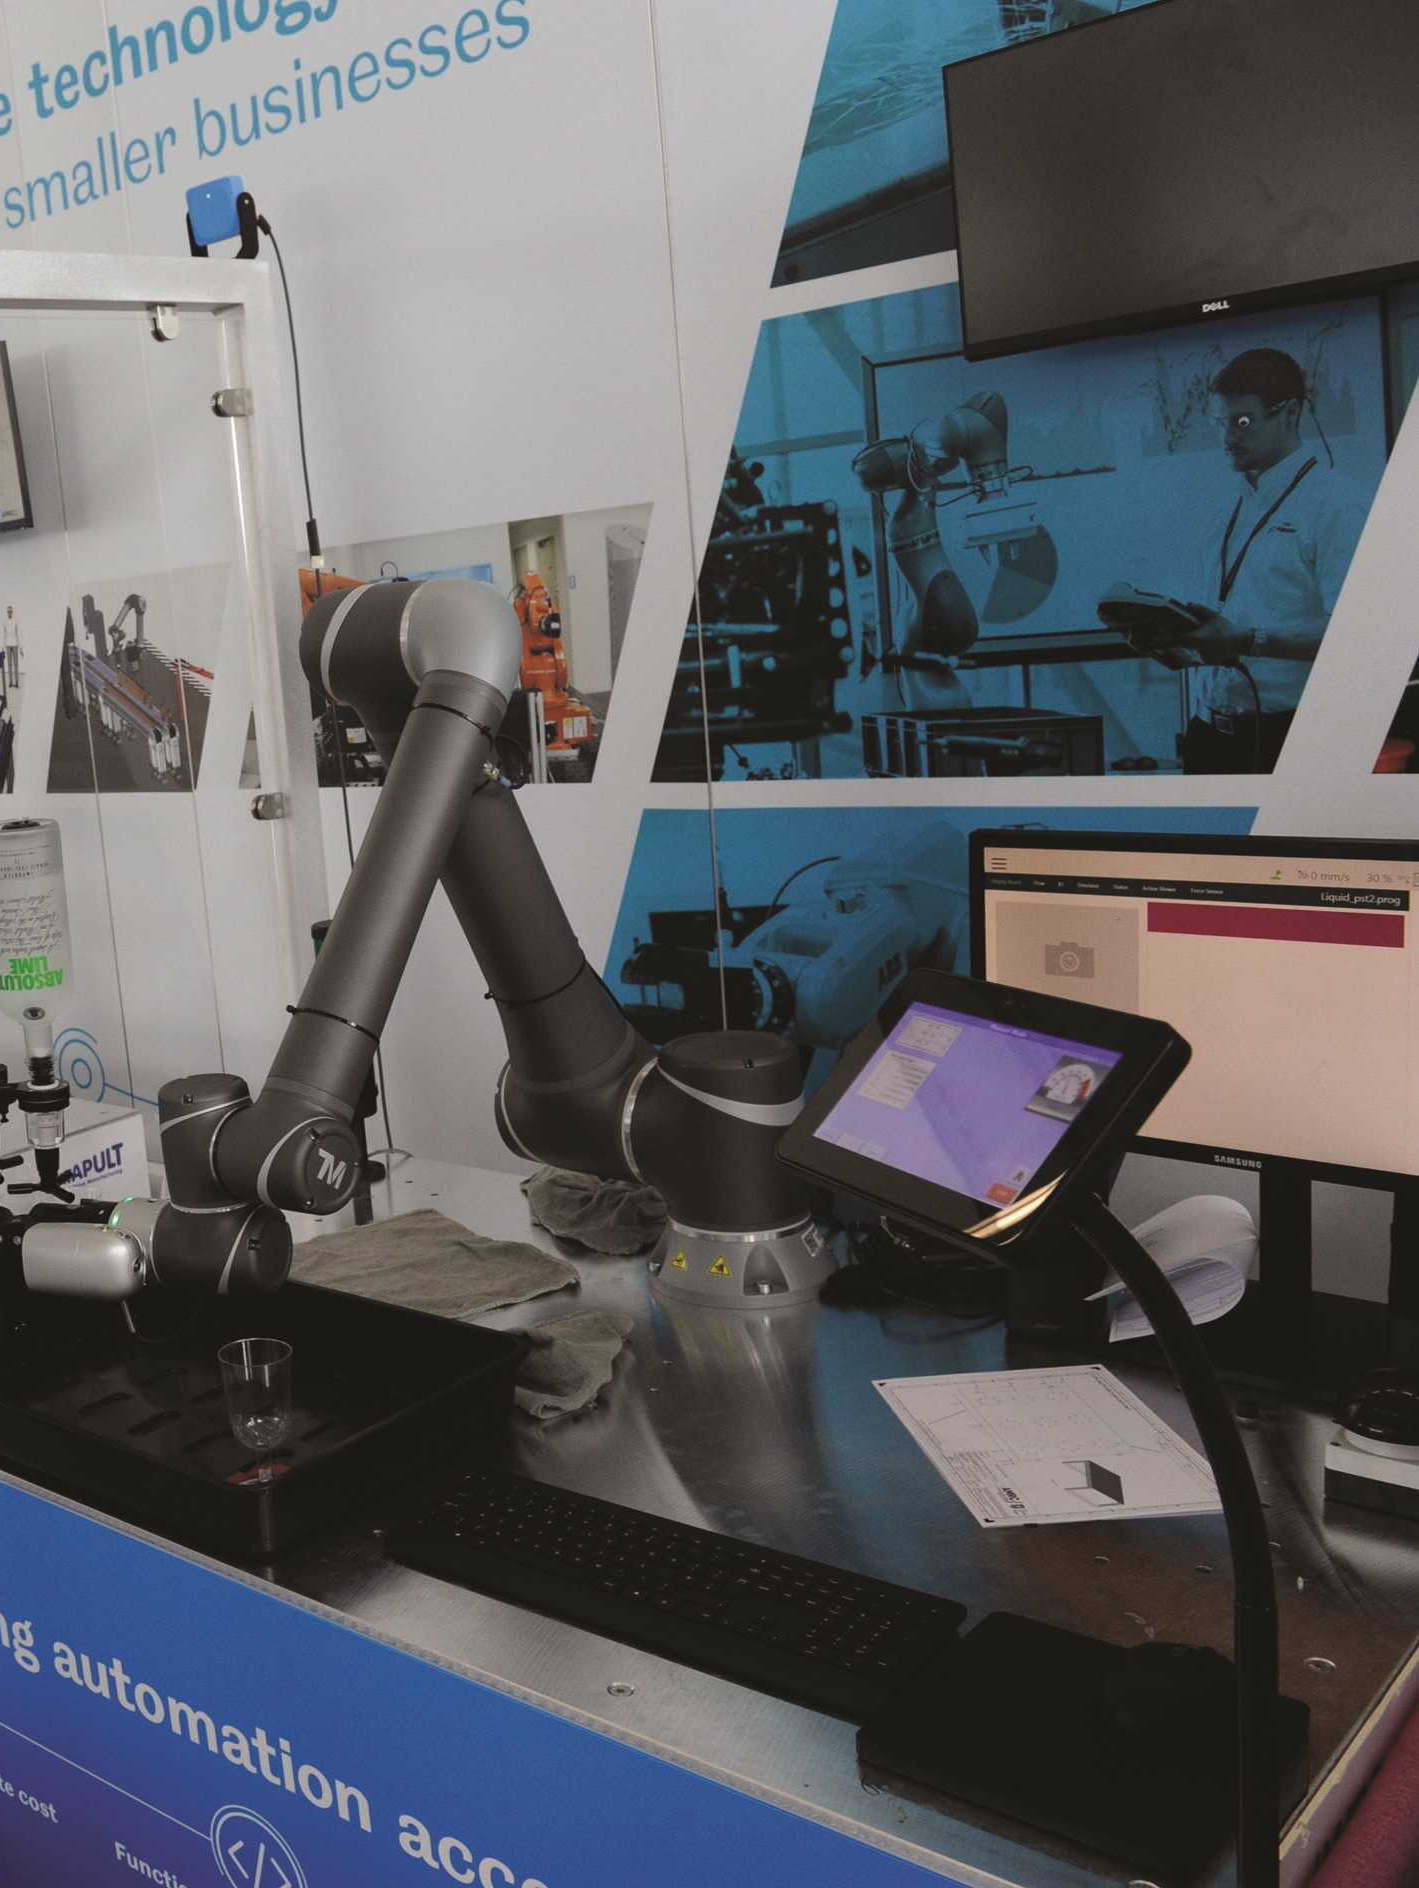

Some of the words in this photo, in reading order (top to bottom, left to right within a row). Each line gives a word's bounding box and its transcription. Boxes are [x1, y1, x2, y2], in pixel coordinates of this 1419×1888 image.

[3, 127, 177, 229] smaller
[193, 0, 530, 160] businesses
[1202, 300, 1230, 313] DELL
[1190, 887, 1206, 895] Force
[1320, 872, 1350, 883] mm/s
[1367, 873, 1380, 883] 30
[1320, 892, 1402, 907] Liquid_pst2.prog
[10, 955, 49, 976] LIME
[63, 1142, 124, 1185] APULT
[317, 1147, 347, 1190] TM
[1213, 1155, 1262, 1169] SAMSUNG
[53, 1640, 372, 1834] automation
[398, 1814, 549, 1888] acc
[19, 1788, 59, 1823] cost
[114, 1841, 188, 1888] Functi
